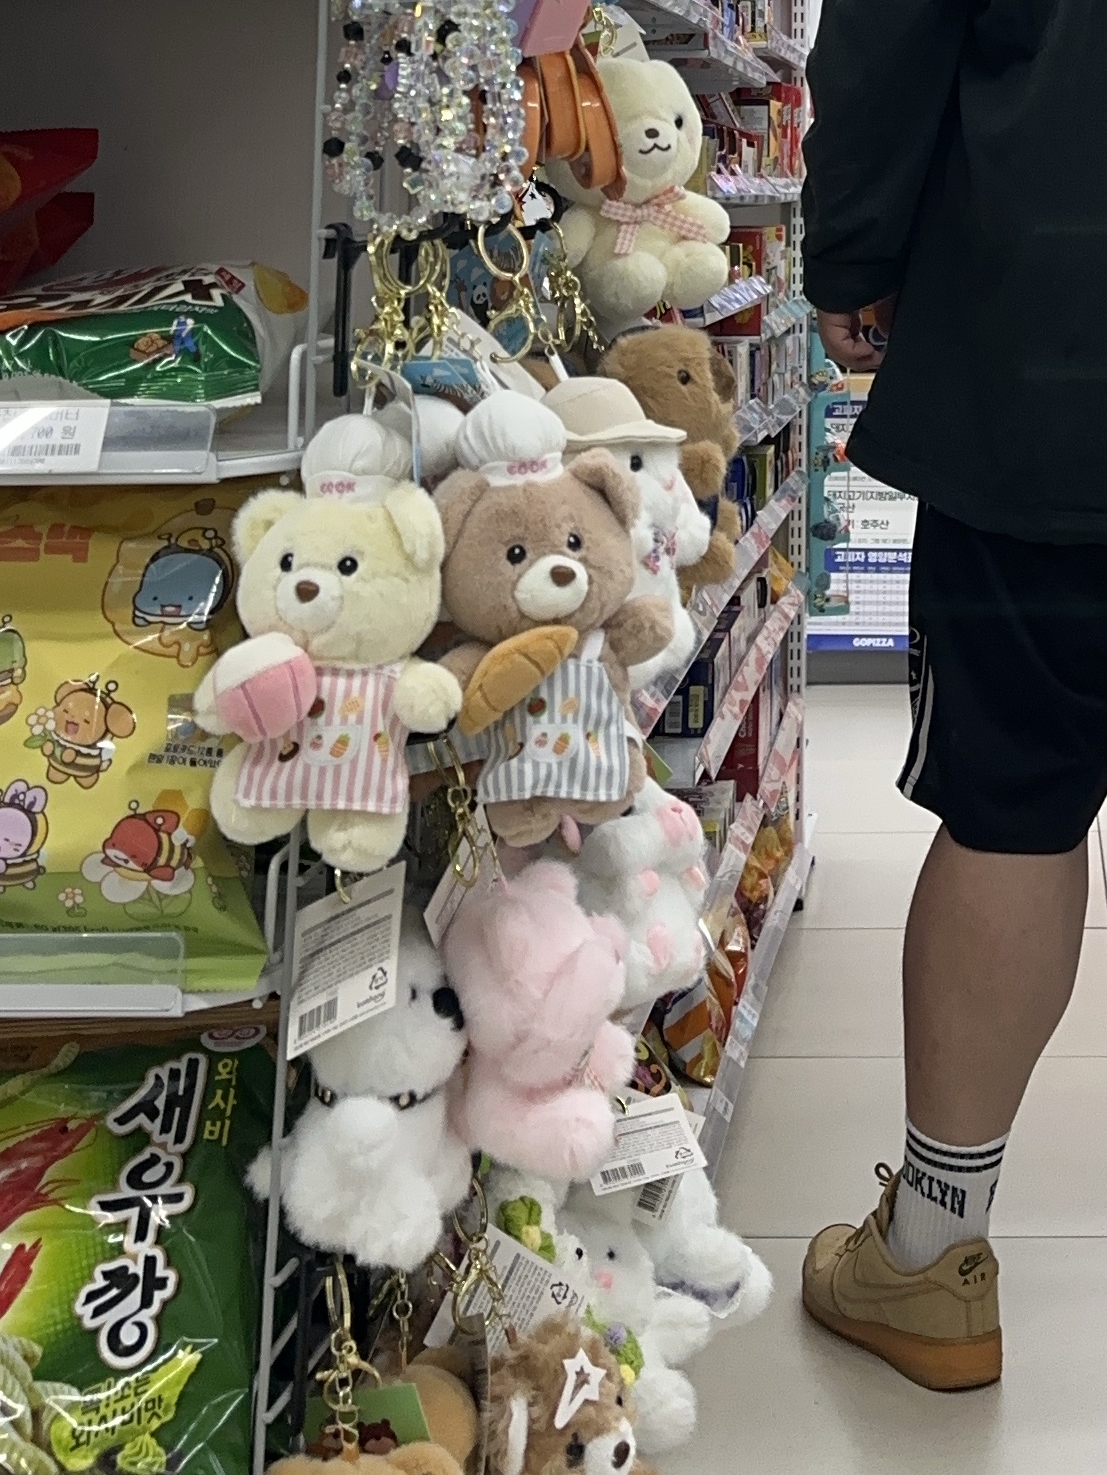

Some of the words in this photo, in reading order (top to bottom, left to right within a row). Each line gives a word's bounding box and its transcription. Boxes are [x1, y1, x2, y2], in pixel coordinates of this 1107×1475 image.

[861, 519, 889, 530] 호주산
[853, 638, 894, 648] GOPIZZA
[84, 1055, 200, 1358] 새우깡
[962, 1272, 986, 1287] AIR
